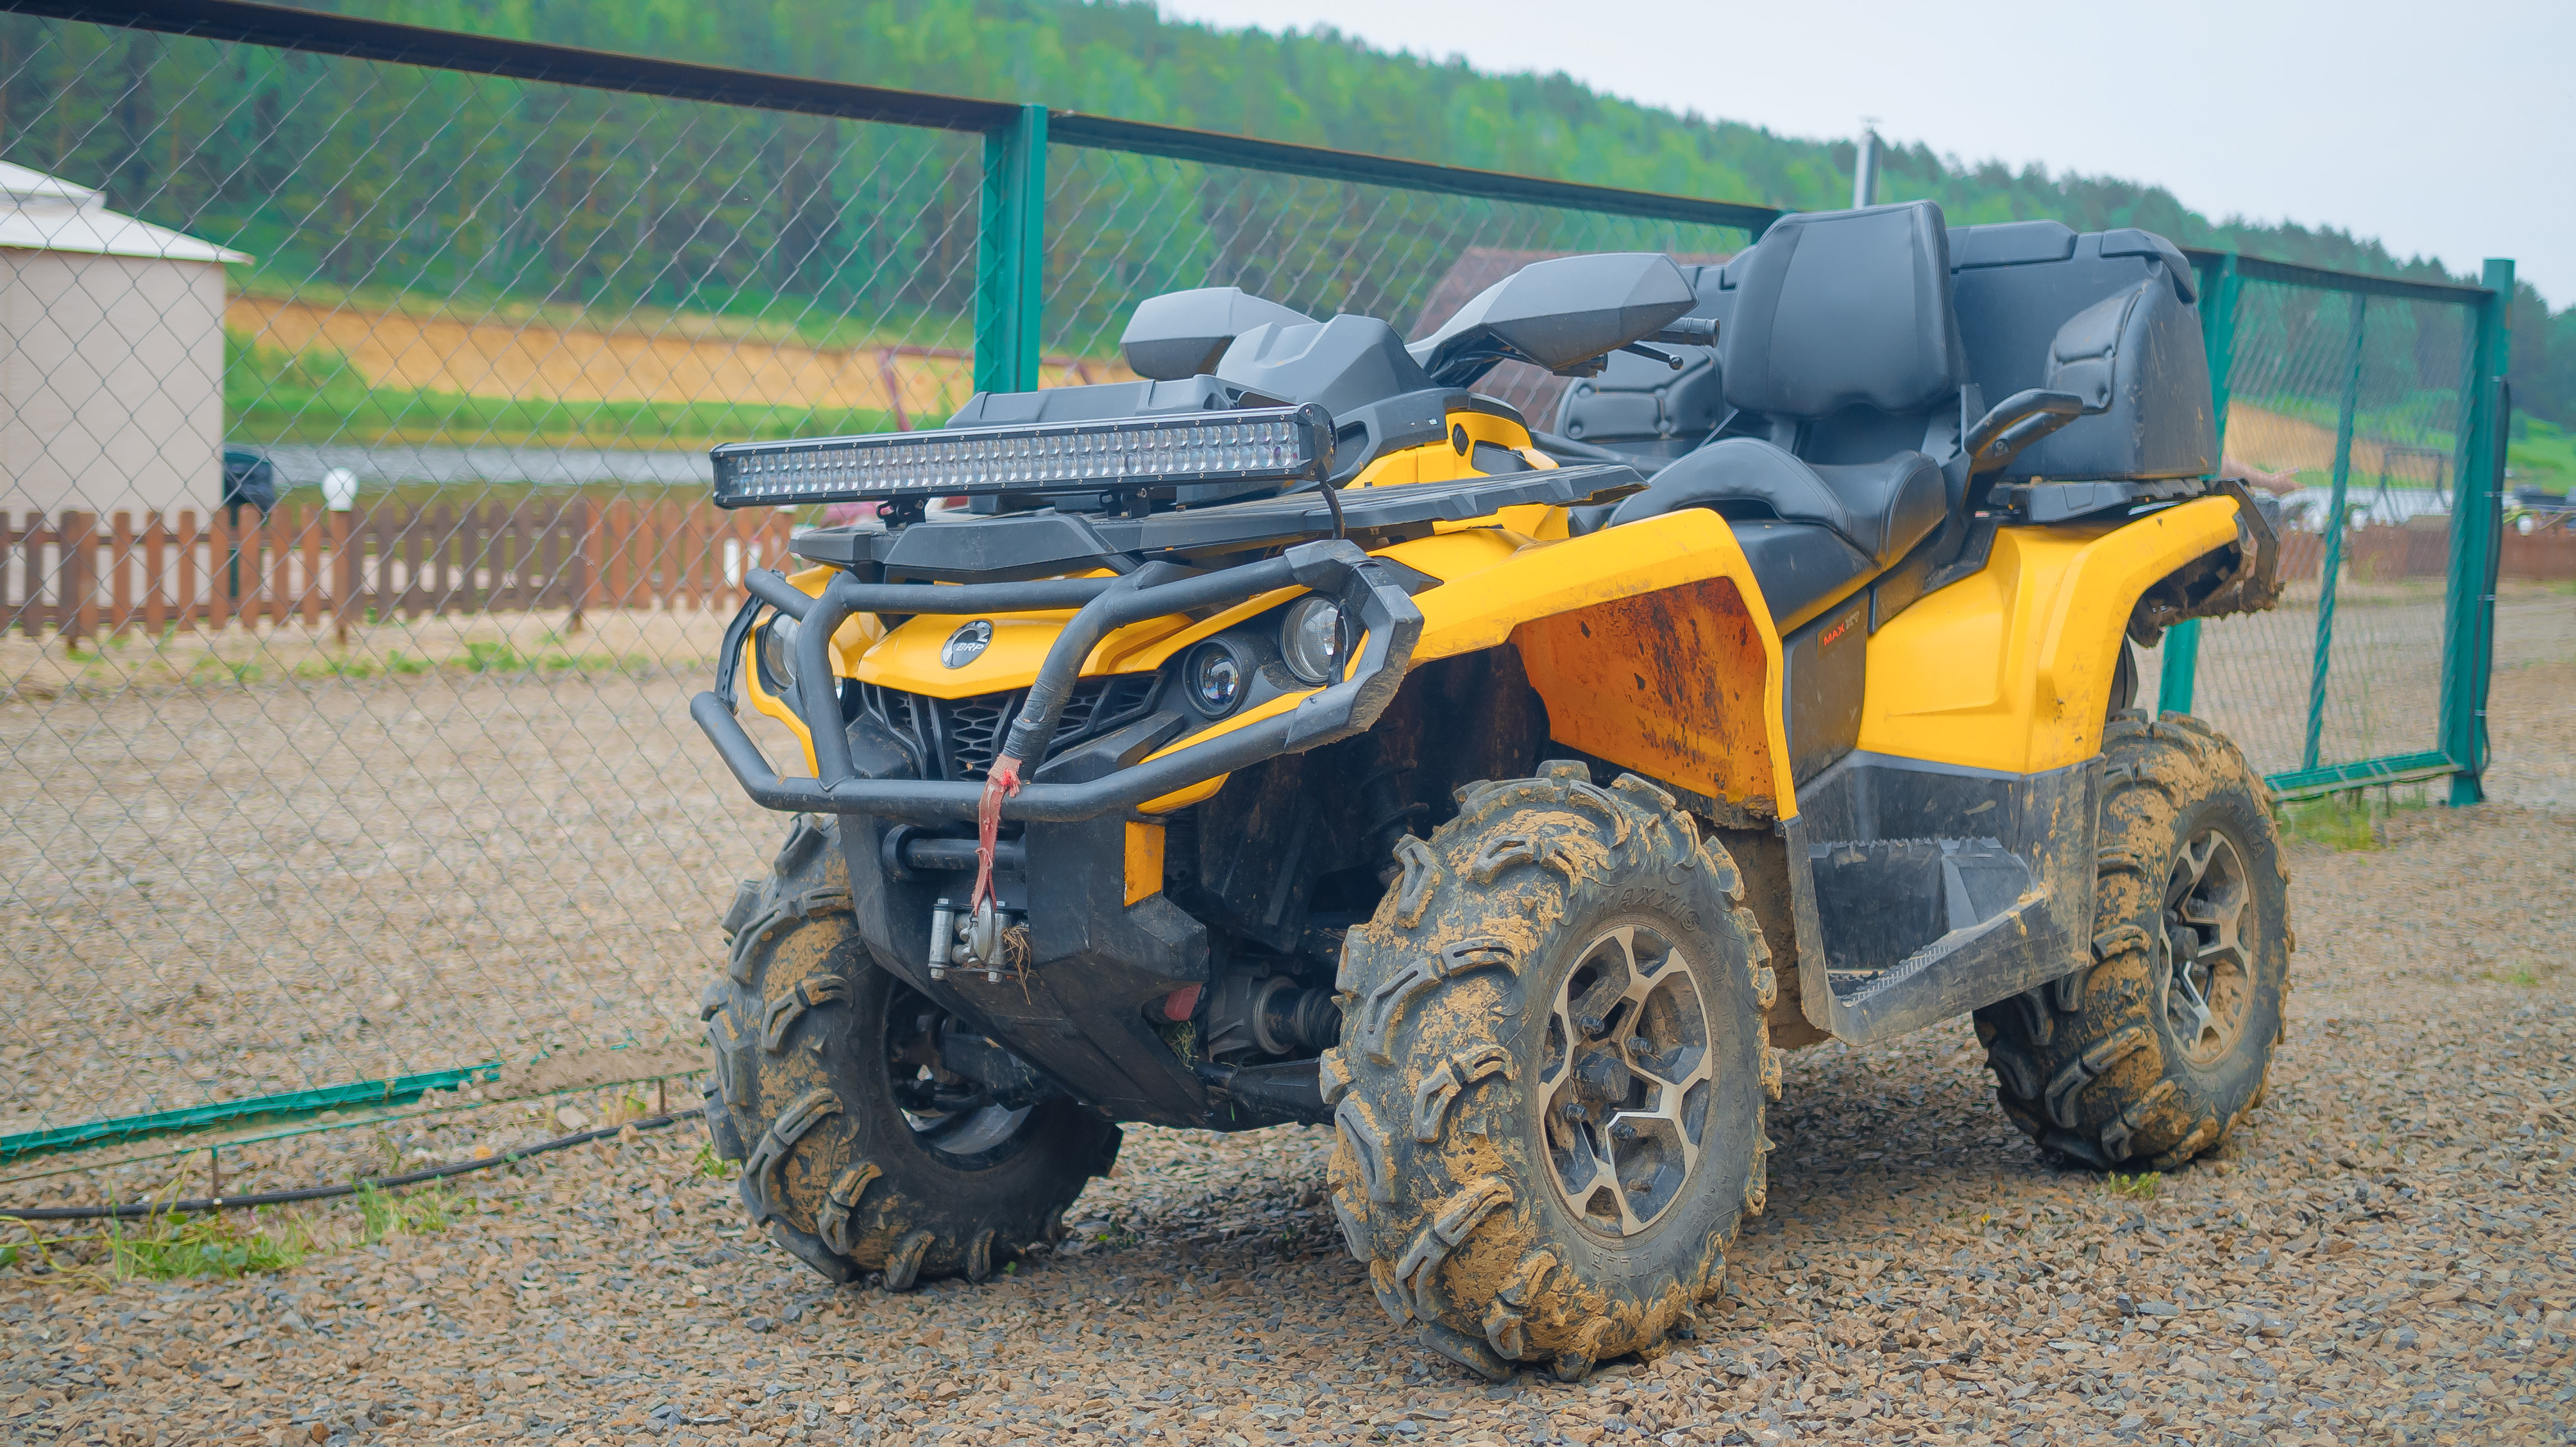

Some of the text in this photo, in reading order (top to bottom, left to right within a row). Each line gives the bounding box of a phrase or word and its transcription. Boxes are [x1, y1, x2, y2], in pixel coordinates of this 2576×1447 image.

[1824, 623, 1845, 647] MAX
[956, 643, 985, 652] BRP
[1595, 885, 1700, 932] MAXXIS
